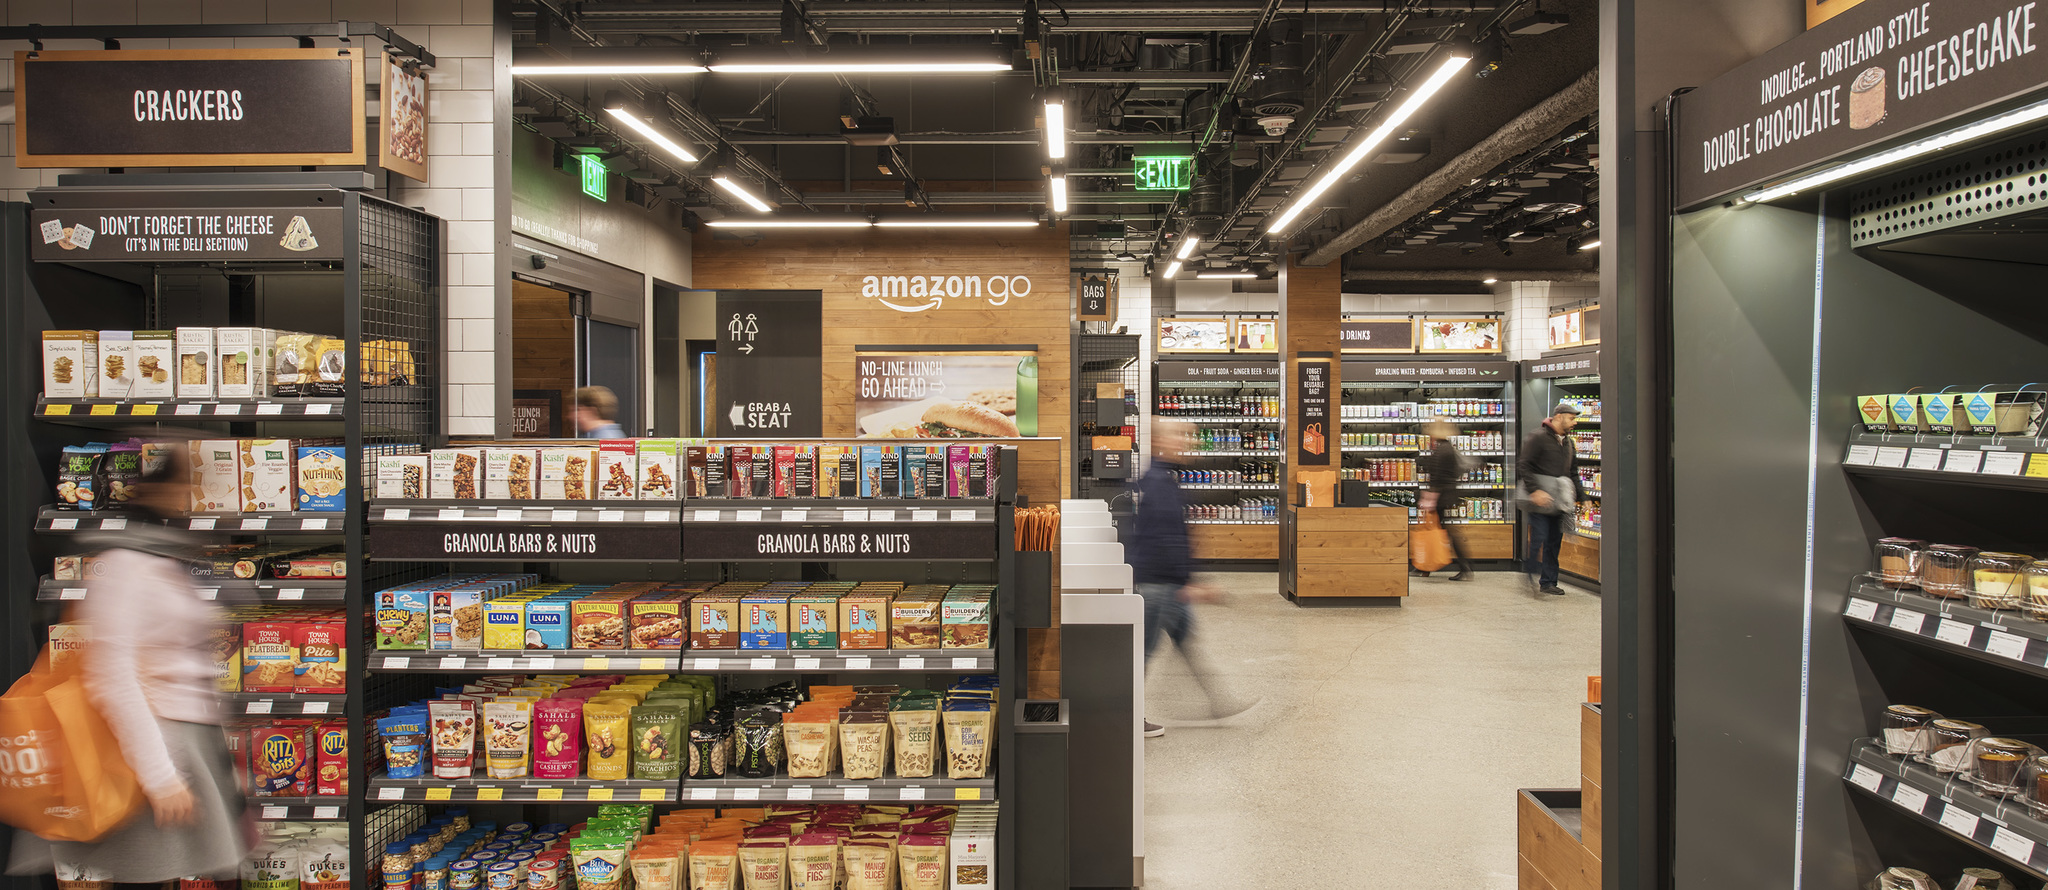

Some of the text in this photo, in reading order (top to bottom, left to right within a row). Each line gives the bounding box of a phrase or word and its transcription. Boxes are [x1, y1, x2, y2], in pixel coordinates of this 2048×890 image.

[1761, 2, 1930, 106] INDULGE... PORTLAND STYLE
[1703, 1, 2036, 174] DOUBLE CHOCOLATE CHEESECAKE
[133, 89, 244, 123] CRACKERS
[587, 160, 605, 197] EXIT
[1146, 159, 1181, 188] EXIT
[100, 215, 274, 236] DON'T FORGET THE CHEESE
[125, 237, 249, 252] (IT'S IN THE DELI SECTION)
[861, 274, 1032, 306] amazon go
[1083, 285, 1105, 298] BAGS
[1346, 330, 1370, 340] DRINKS
[861, 360, 943, 377] NO-LINE LUNCH
[1187, 367, 1263, 375] COLA FRUIT SODA GINGER BEER
[1306, 367, 1322, 375] FORGET
[1375, 367, 1477, 375] SPARKLING WATER KOMBUCHA INFUSED TEA
[1308, 374, 1321, 382] YOUR
[861, 377, 926, 399] GO AHEAD
[518, 407, 541, 418] LUNCH
[748, 402, 791, 413] GRAB A
[748, 412, 792, 429] SEAT
[68, 454, 94, 464] NEW
[114, 453, 139, 463] NEW
[433, 452, 454, 461] Kashi
[488, 452, 509, 461] Kashi
[543, 453, 565, 462] Kashi
[68, 463, 91, 472] YORK
[115, 462, 137, 470] YORK
[379, 459, 401, 468] Kashi
[443, 533, 597, 554] GRANOLA BARS & NUTS
[757, 533, 911, 554] GRANOLA BARS & NUTS
[577, 603, 618, 614] NATURE VALLEY
[635, 604, 678, 614] NATURE VALLEY
[308, 637, 330, 645] HOUSE
[249, 645, 290, 653] FLATBREAD
[304, 646, 335, 657] Pita
[637, 714, 676, 722] SAHALE
[385, 725, 419, 734] PLANTERS
[908, 732, 931, 742] SEEDS
[323, 734, 345, 752] RITZ
[264, 740, 292, 761] RITZ
[856, 744, 873, 753] PEAS
[271, 757, 295, 773] bits
[539, 763, 573, 771] CASHEWS
[253, 860, 287, 870] DUKE'S
[309, 862, 346, 872] DUKE'S
[580, 865, 615, 873] DIAMOND
[589, 860, 605, 868] BLUE
[809, 862, 833, 871] MISSION
[864, 862, 886, 871] MANGO
[920, 863, 941, 871] BANANA
[706, 867, 729, 876] TAMARI
[754, 871, 779, 880] RAISINS
[806, 871, 824, 882] FIGS
[864, 871, 886, 879] SLICES
[920, 871, 937, 879] CHIPS
[647, 875, 671, 883] ALMONDS
